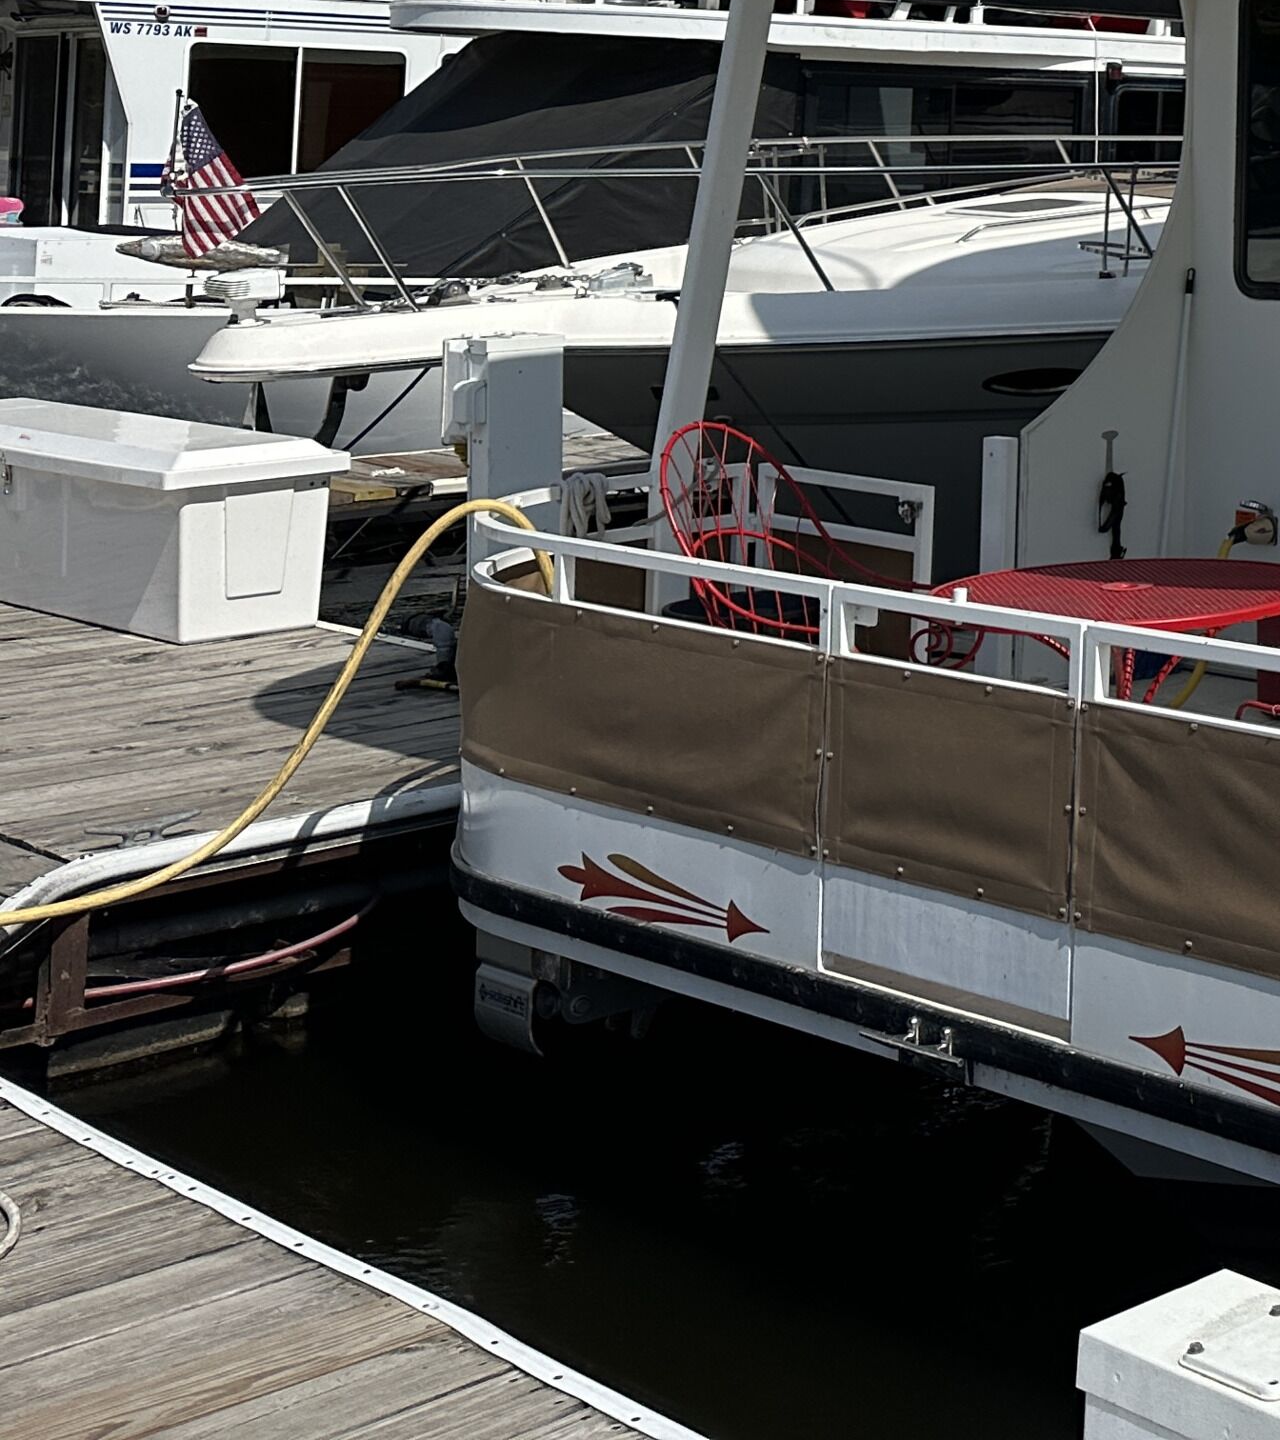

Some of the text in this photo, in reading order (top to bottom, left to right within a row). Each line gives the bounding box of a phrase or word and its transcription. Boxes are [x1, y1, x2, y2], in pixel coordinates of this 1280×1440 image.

[110, 22, 193, 37] WS 7793 AK
